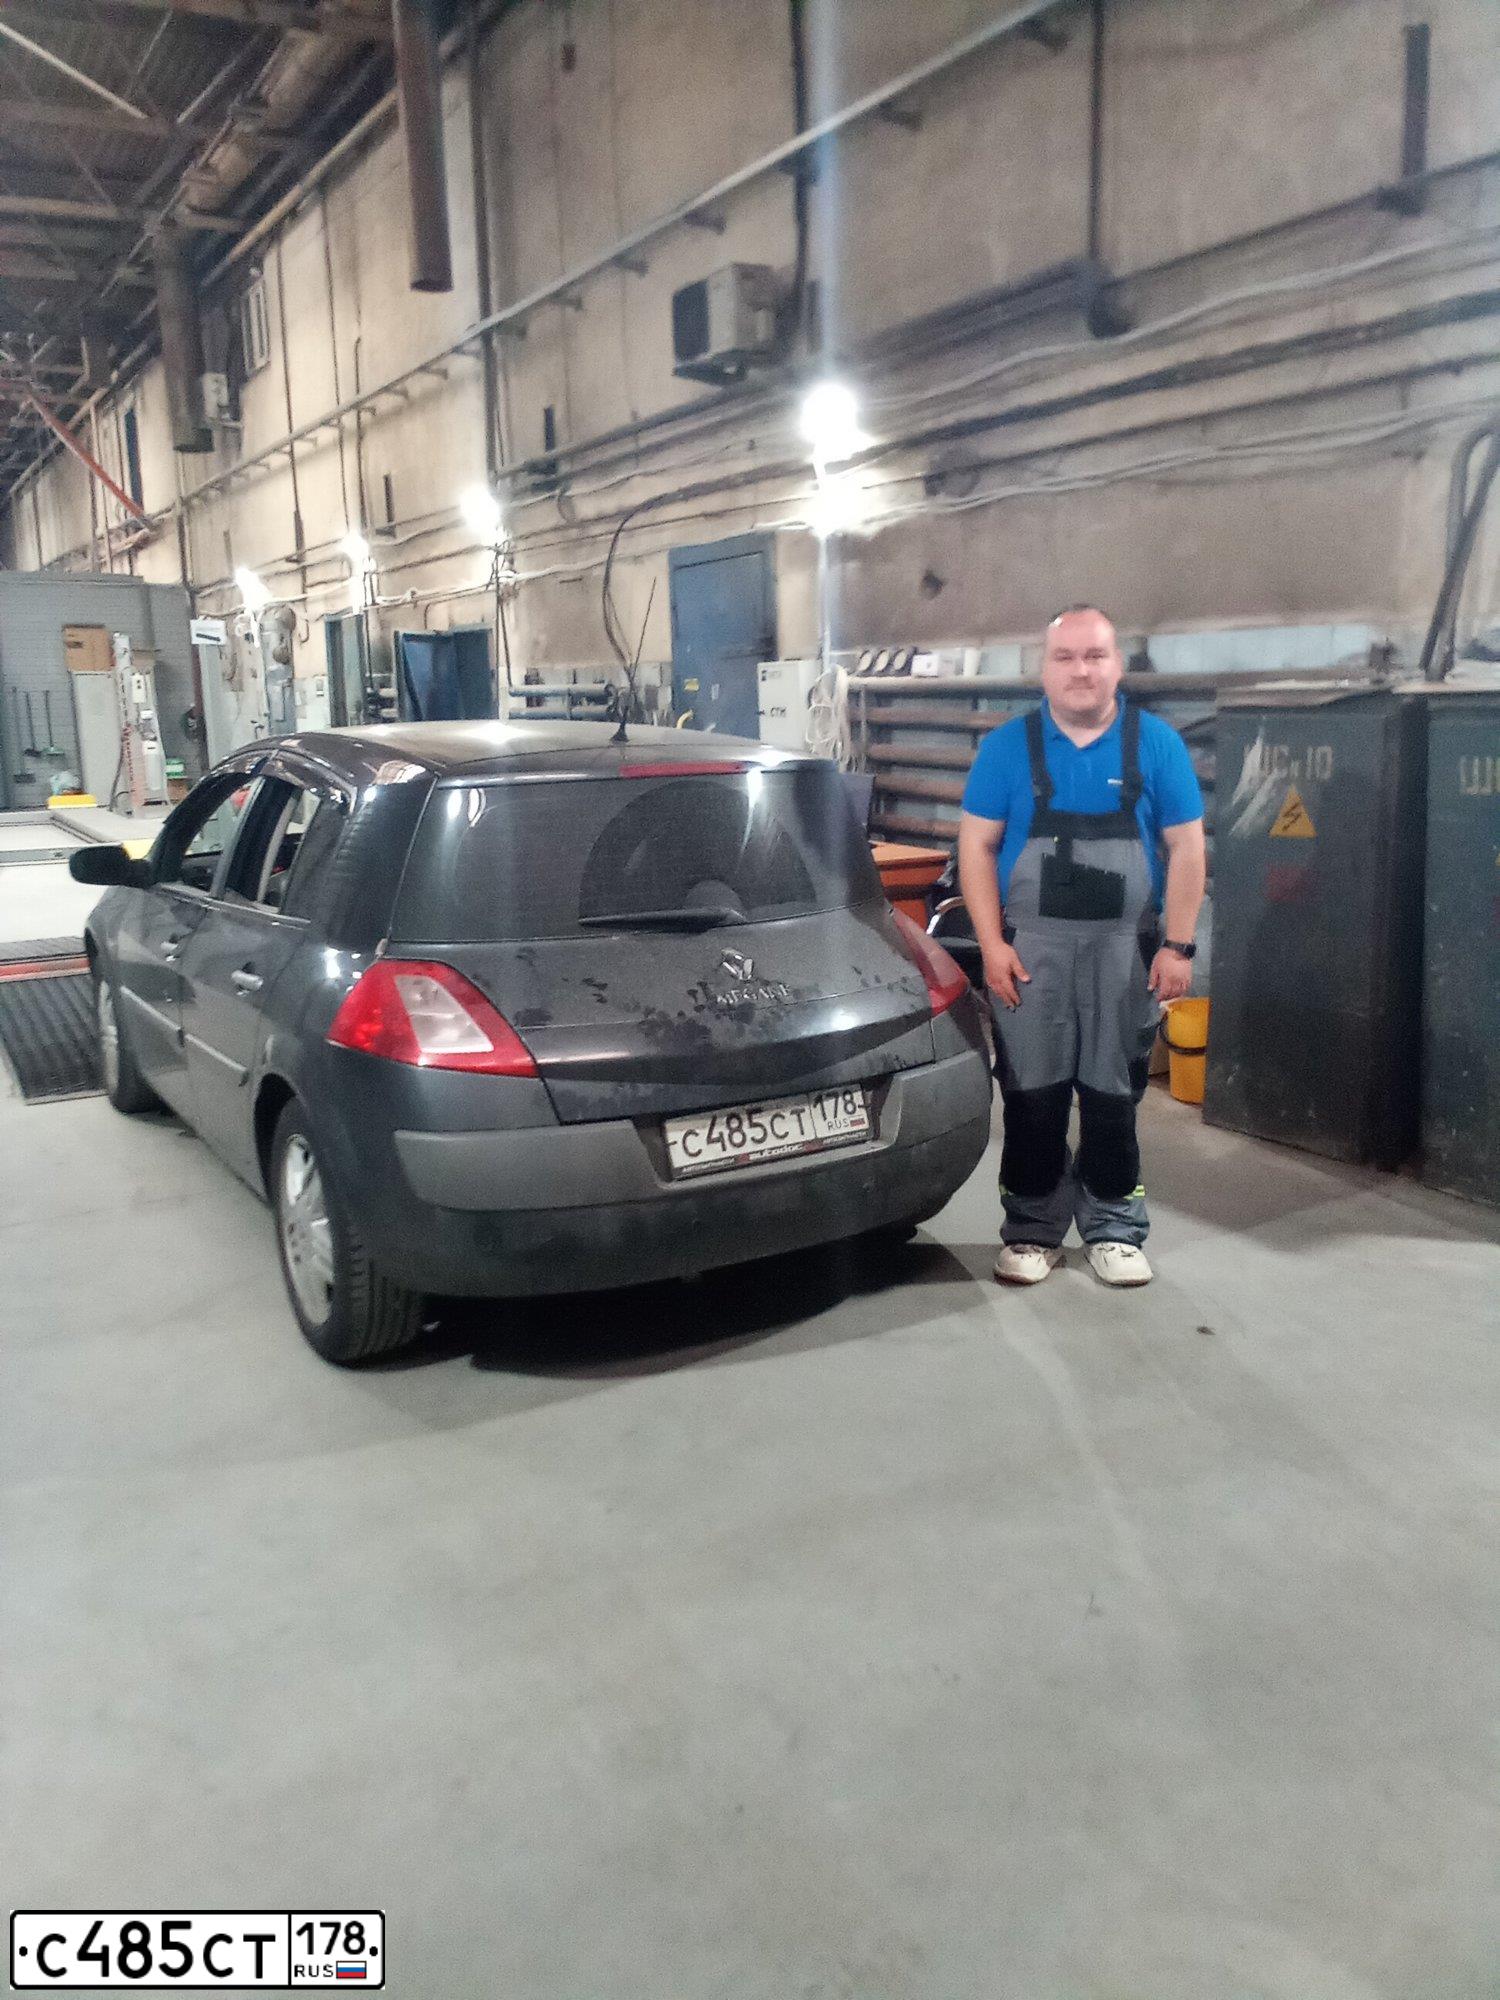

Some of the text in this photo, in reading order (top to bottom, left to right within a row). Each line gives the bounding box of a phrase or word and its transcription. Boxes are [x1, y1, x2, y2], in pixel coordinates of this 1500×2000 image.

[682, 1089, 857, 1157] С485СТ 178
[827, 1118, 850, 1131] RUS
